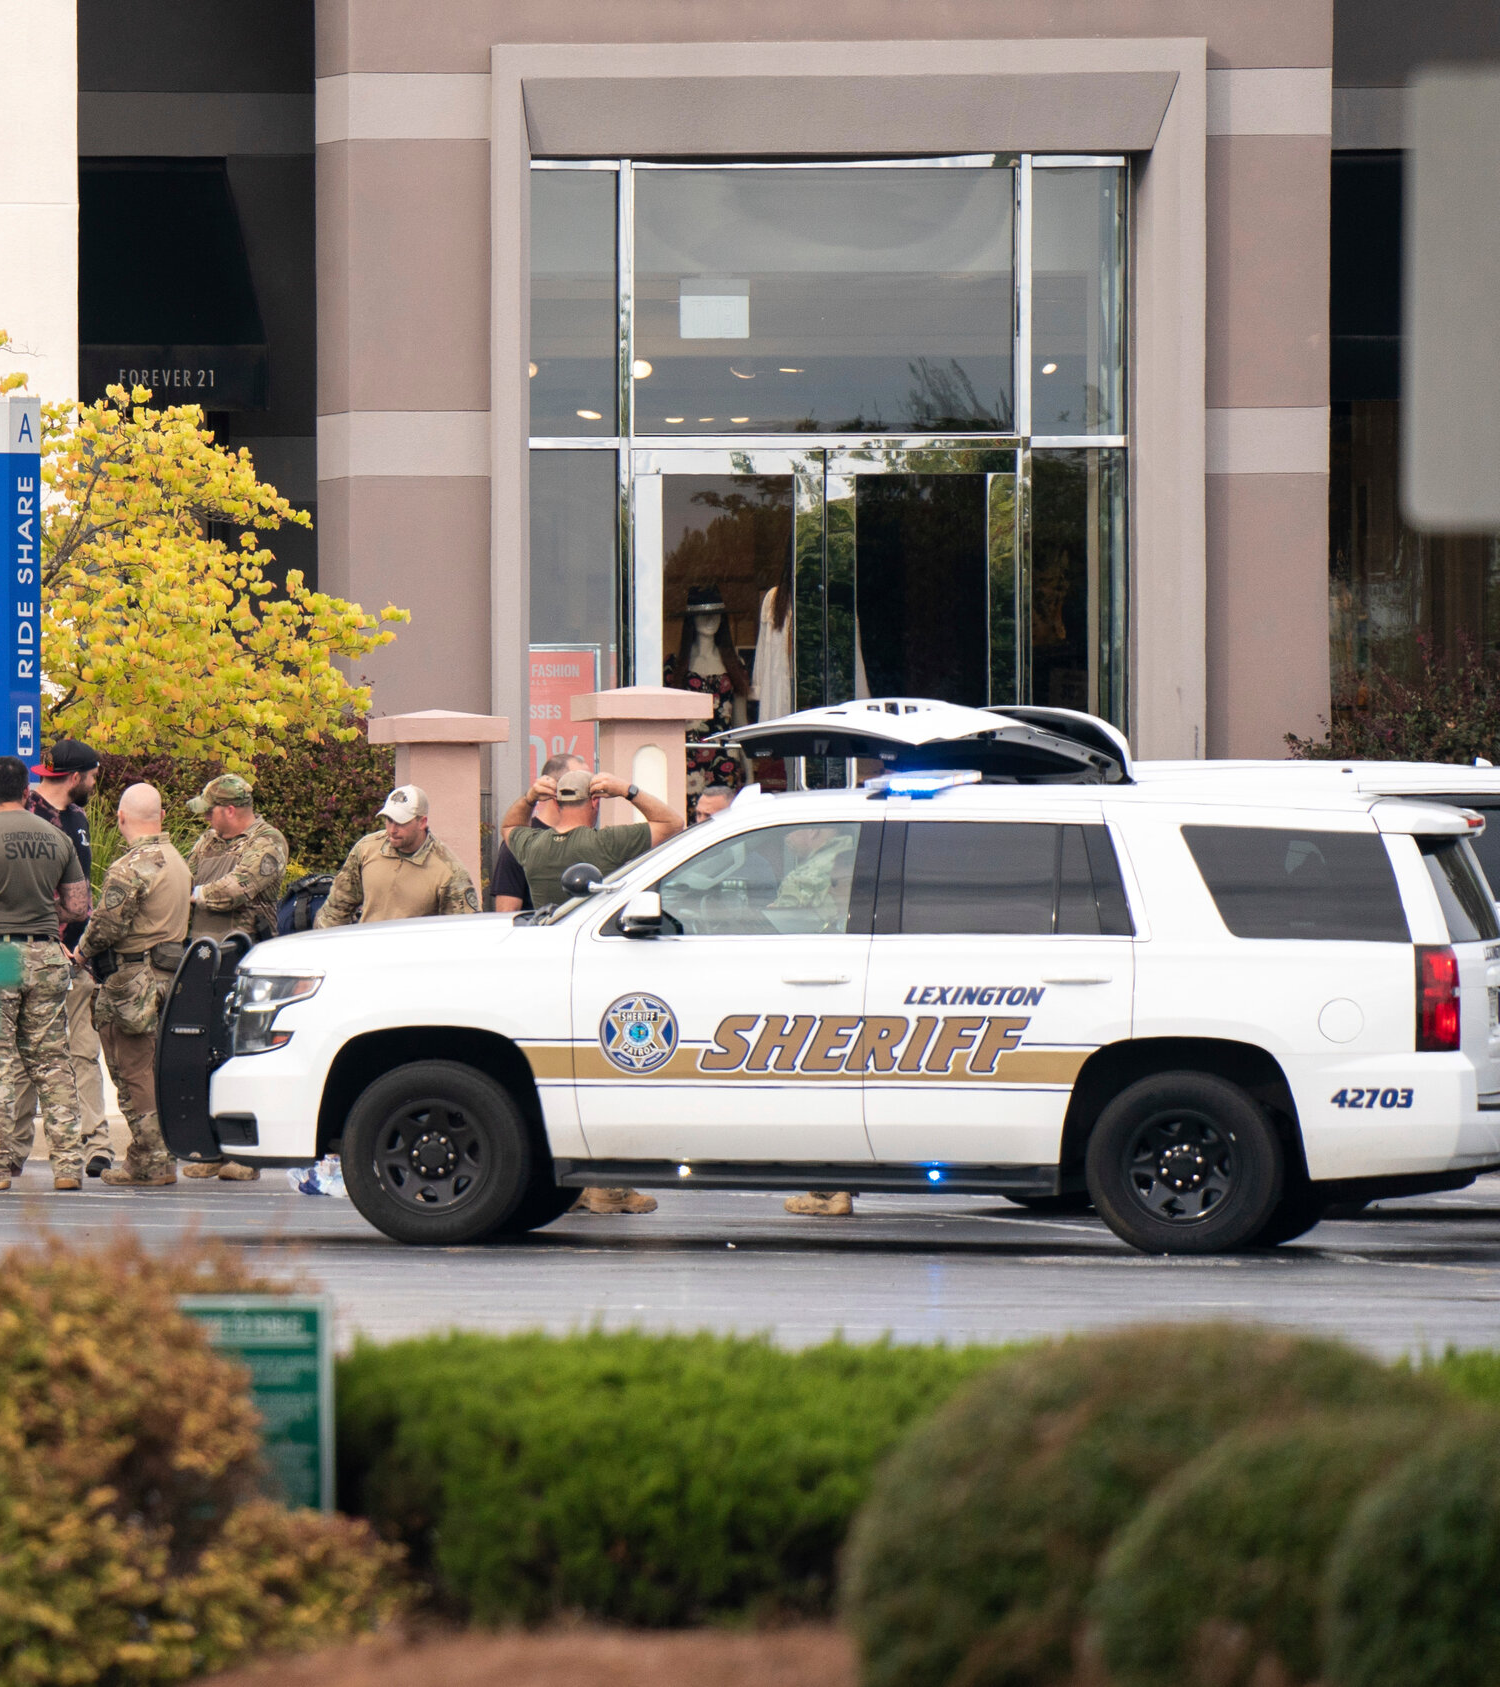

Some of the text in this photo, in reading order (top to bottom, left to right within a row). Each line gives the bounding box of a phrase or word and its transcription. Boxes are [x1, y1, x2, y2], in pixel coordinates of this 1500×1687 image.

[120, 369, 214, 387] FOREVER 21
[18, 413, 33, 443] A
[17, 477, 33, 678] RIDE SHARE
[531, 664, 580, 677] FASHION
[5, 841, 58, 860] SWAT
[904, 986, 1046, 1006] LEXINGTON
[621, 1012, 656, 1021] SHERIFF
[623, 1043, 655, 1056] PATROL
[699, 1014, 1032, 1073] SHERIFF
[1331, 1088, 1414, 1108] 42703
